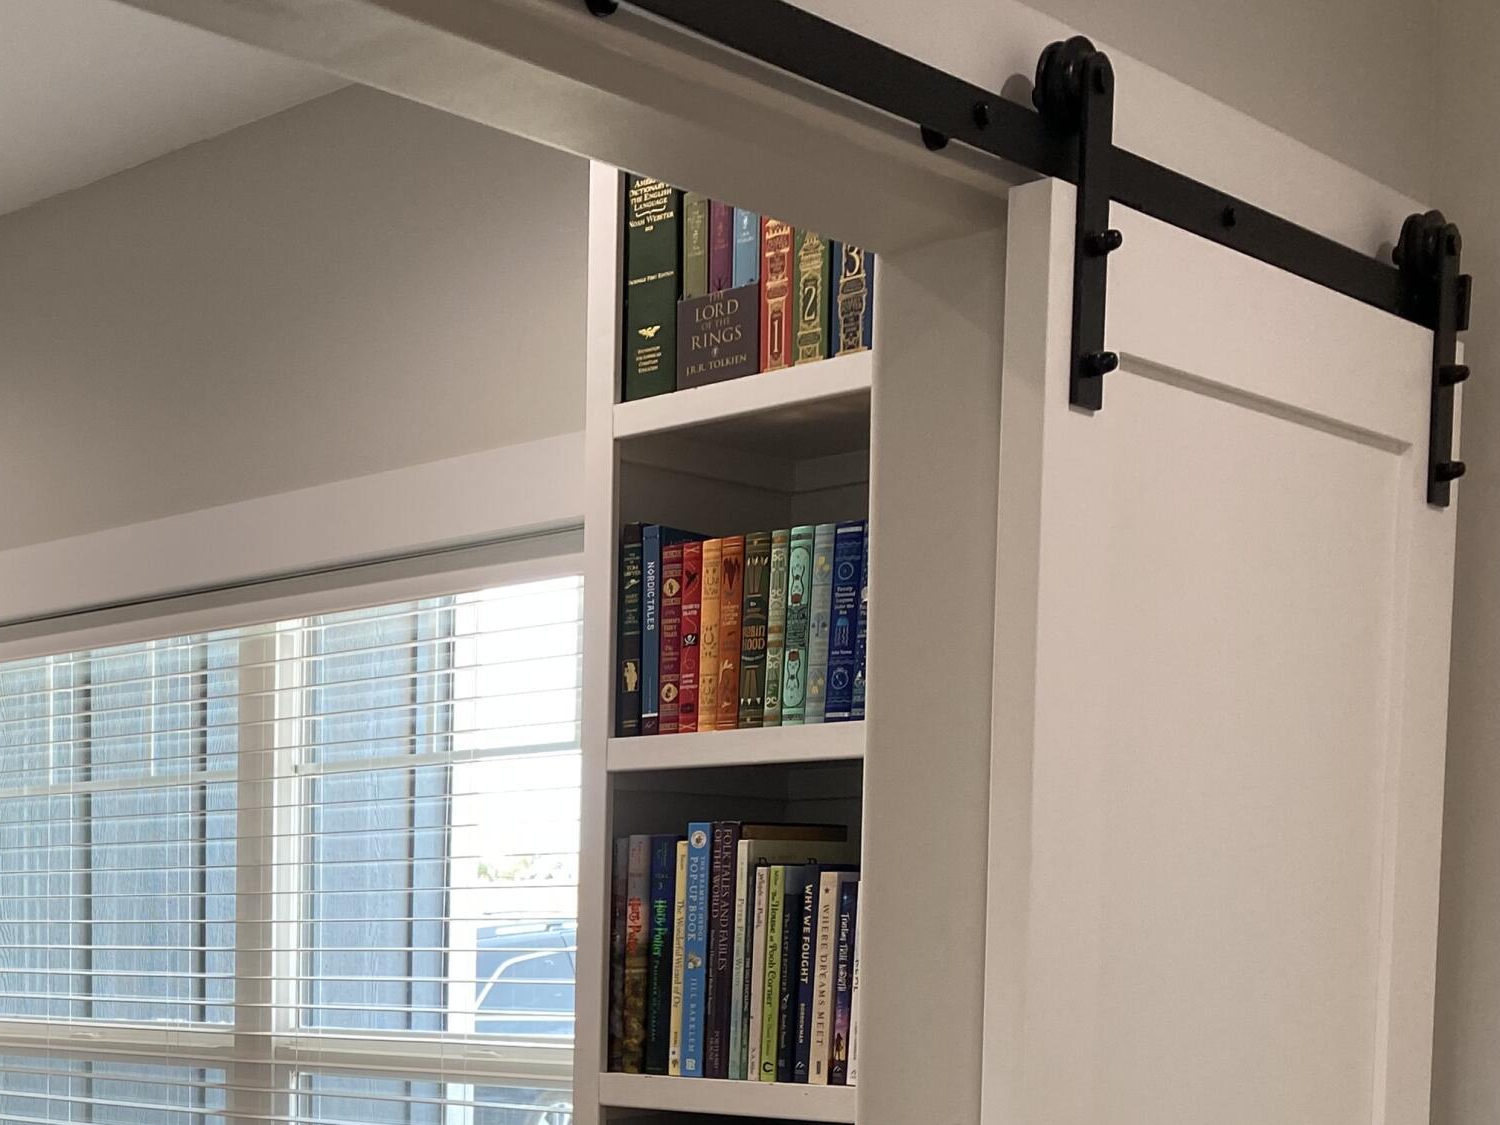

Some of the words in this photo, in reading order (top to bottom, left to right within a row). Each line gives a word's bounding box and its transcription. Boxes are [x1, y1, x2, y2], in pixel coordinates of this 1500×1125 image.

[634, 197, 668, 211] LANGUAGE
[644, 188, 672, 201] ENGLISH
[646, 211, 674, 223] WEBSTER
[846, 244, 861, 277] 3
[695, 299, 739, 323] LORD
[709, 291, 724, 303] THE
[804, 285, 817, 322] 2
[691, 324, 742, 351] RINGS
[701, 320, 713, 331] OF
[715, 316, 731, 328] THE
[772, 319, 780, 354] 1
[708, 354, 747, 370] TOLKIEN
[646, 561, 655, 598] NORDIC
[646, 598, 655, 631] TALES
[714, 829, 721, 843] OF
[722, 829, 733, 859] FOLK
[713, 849, 721, 872] THE
[689, 856, 699, 901] POP-UP
[698, 873, 706, 911] BRAMBLY
[721, 861, 732, 897] TALES
[627, 897, 642, 925] Harry
[711, 874, 721, 918] WORLD
[804, 884, 814, 912] WHY
[653, 898, 668, 926] Harry
[687, 905, 698, 942] BOOK
[697, 912, 705, 942] HEDGE
[719, 899, 730, 928] AND
[770, 901, 780, 934] House
[803, 915, 812, 933] WE
[625, 925, 643, 958] Potter
[651, 927, 668, 957] Potter
[675, 915, 684, 957] Wonderful
[736, 926, 744, 943] PAN
[820, 904, 831, 952] WHERE
[718, 929, 729, 971] FABLES
[768, 943, 777, 968] Pooh
[800, 936, 811, 984] FOUGHT
[838, 943, 849, 962] TRUE
[674, 957, 683, 985] Wizard
[735, 957, 743, 987] WENDY
[818, 954, 829, 1007] DREAMS
[836, 963, 847, 992] NORTH
[673, 996, 681, 1008] Oz
[674, 986, 682, 995] of
[766, 970, 776, 1006] Corner
[688, 1003, 697, 1052] BARKLEM
[816, 1011, 826, 1047] MEET
